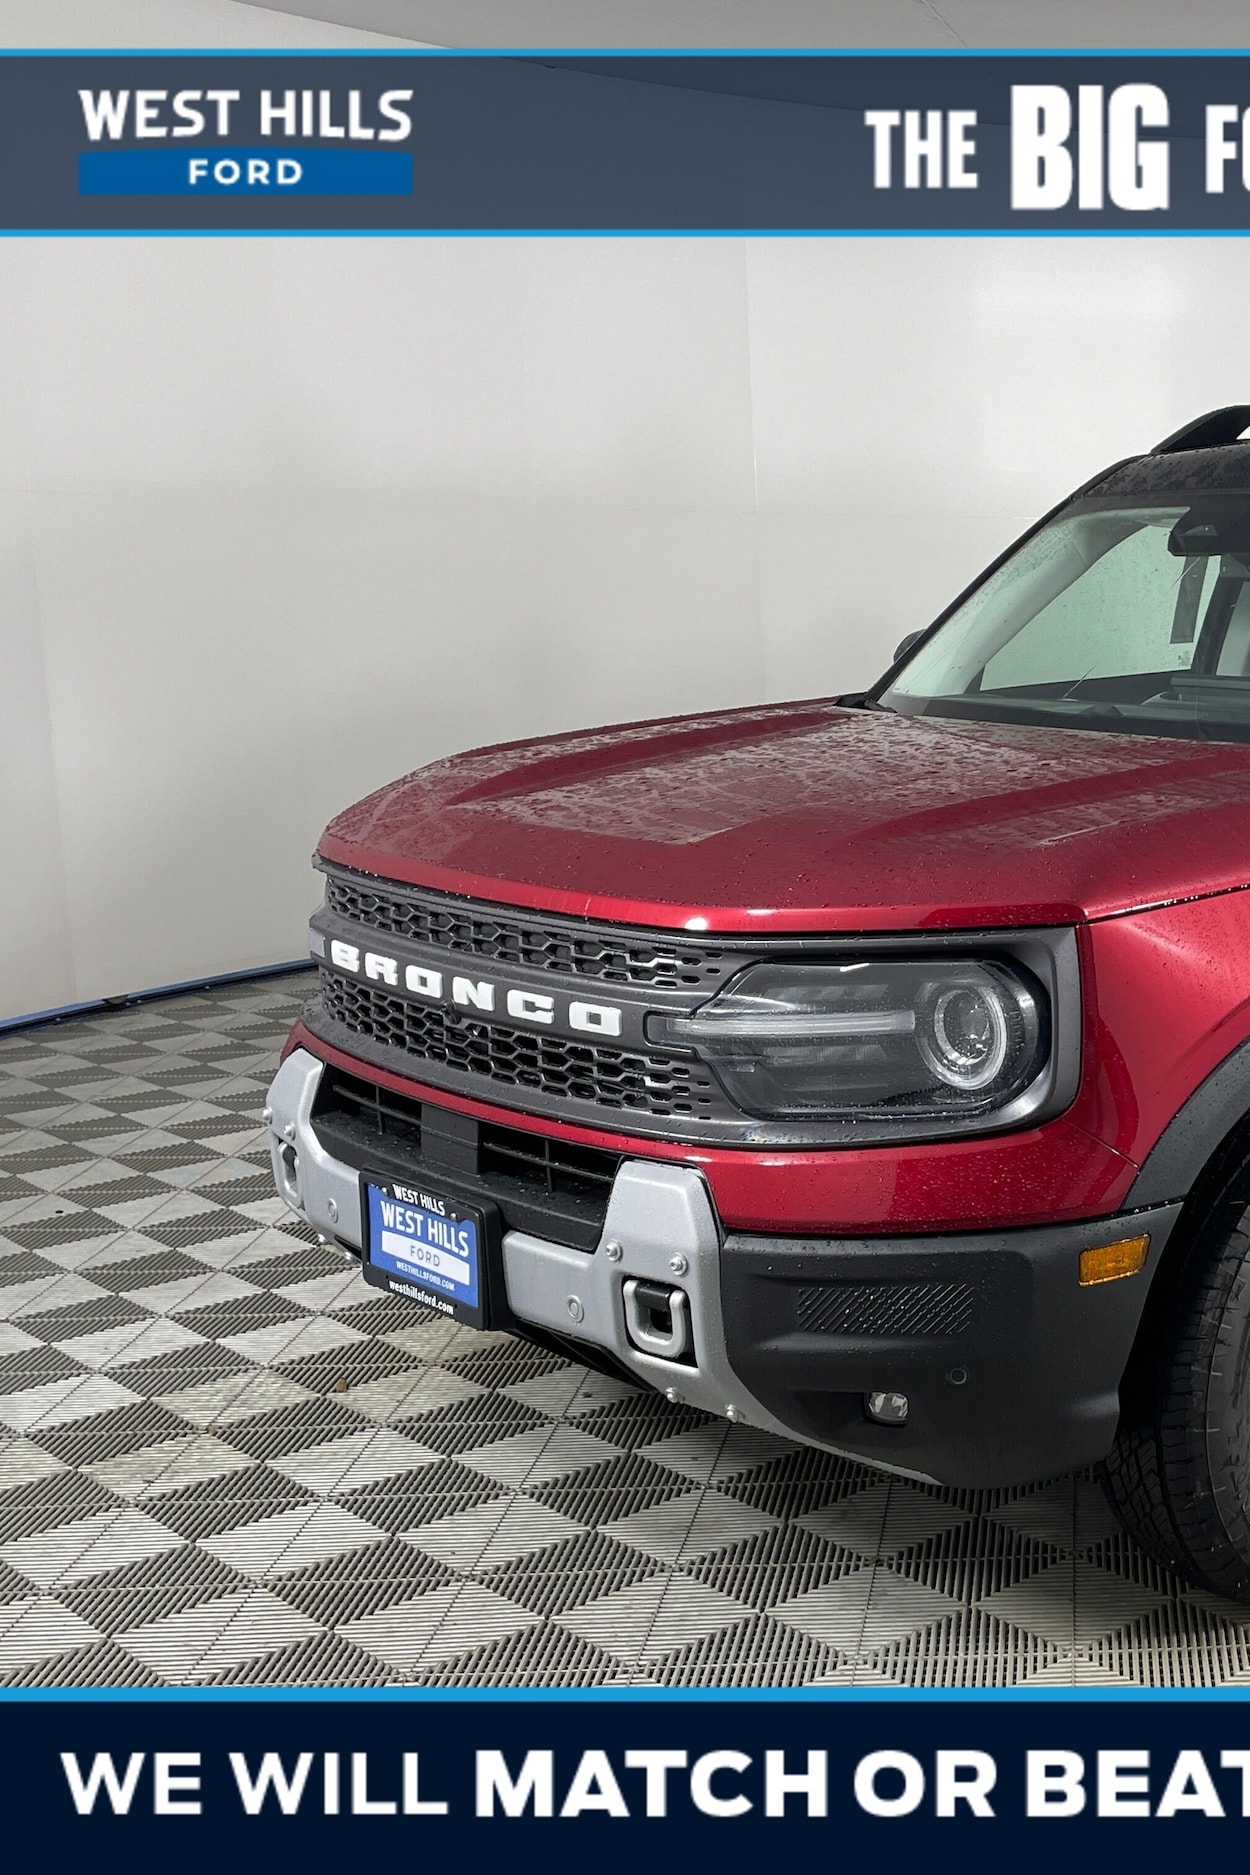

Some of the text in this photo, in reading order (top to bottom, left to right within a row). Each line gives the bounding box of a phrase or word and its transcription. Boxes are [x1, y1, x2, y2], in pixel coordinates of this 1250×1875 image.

[330, 939, 622, 1037] BRONCO
[393, 1183, 446, 1217] WEST HILLS
[380, 1200, 469, 1258] WEST HILLS
[410, 1245, 440, 1267] FORD
[396, 1261, 455, 1291] WESTHILLSFORD.COM
[389, 1280, 454, 1315] westhillsford.com
